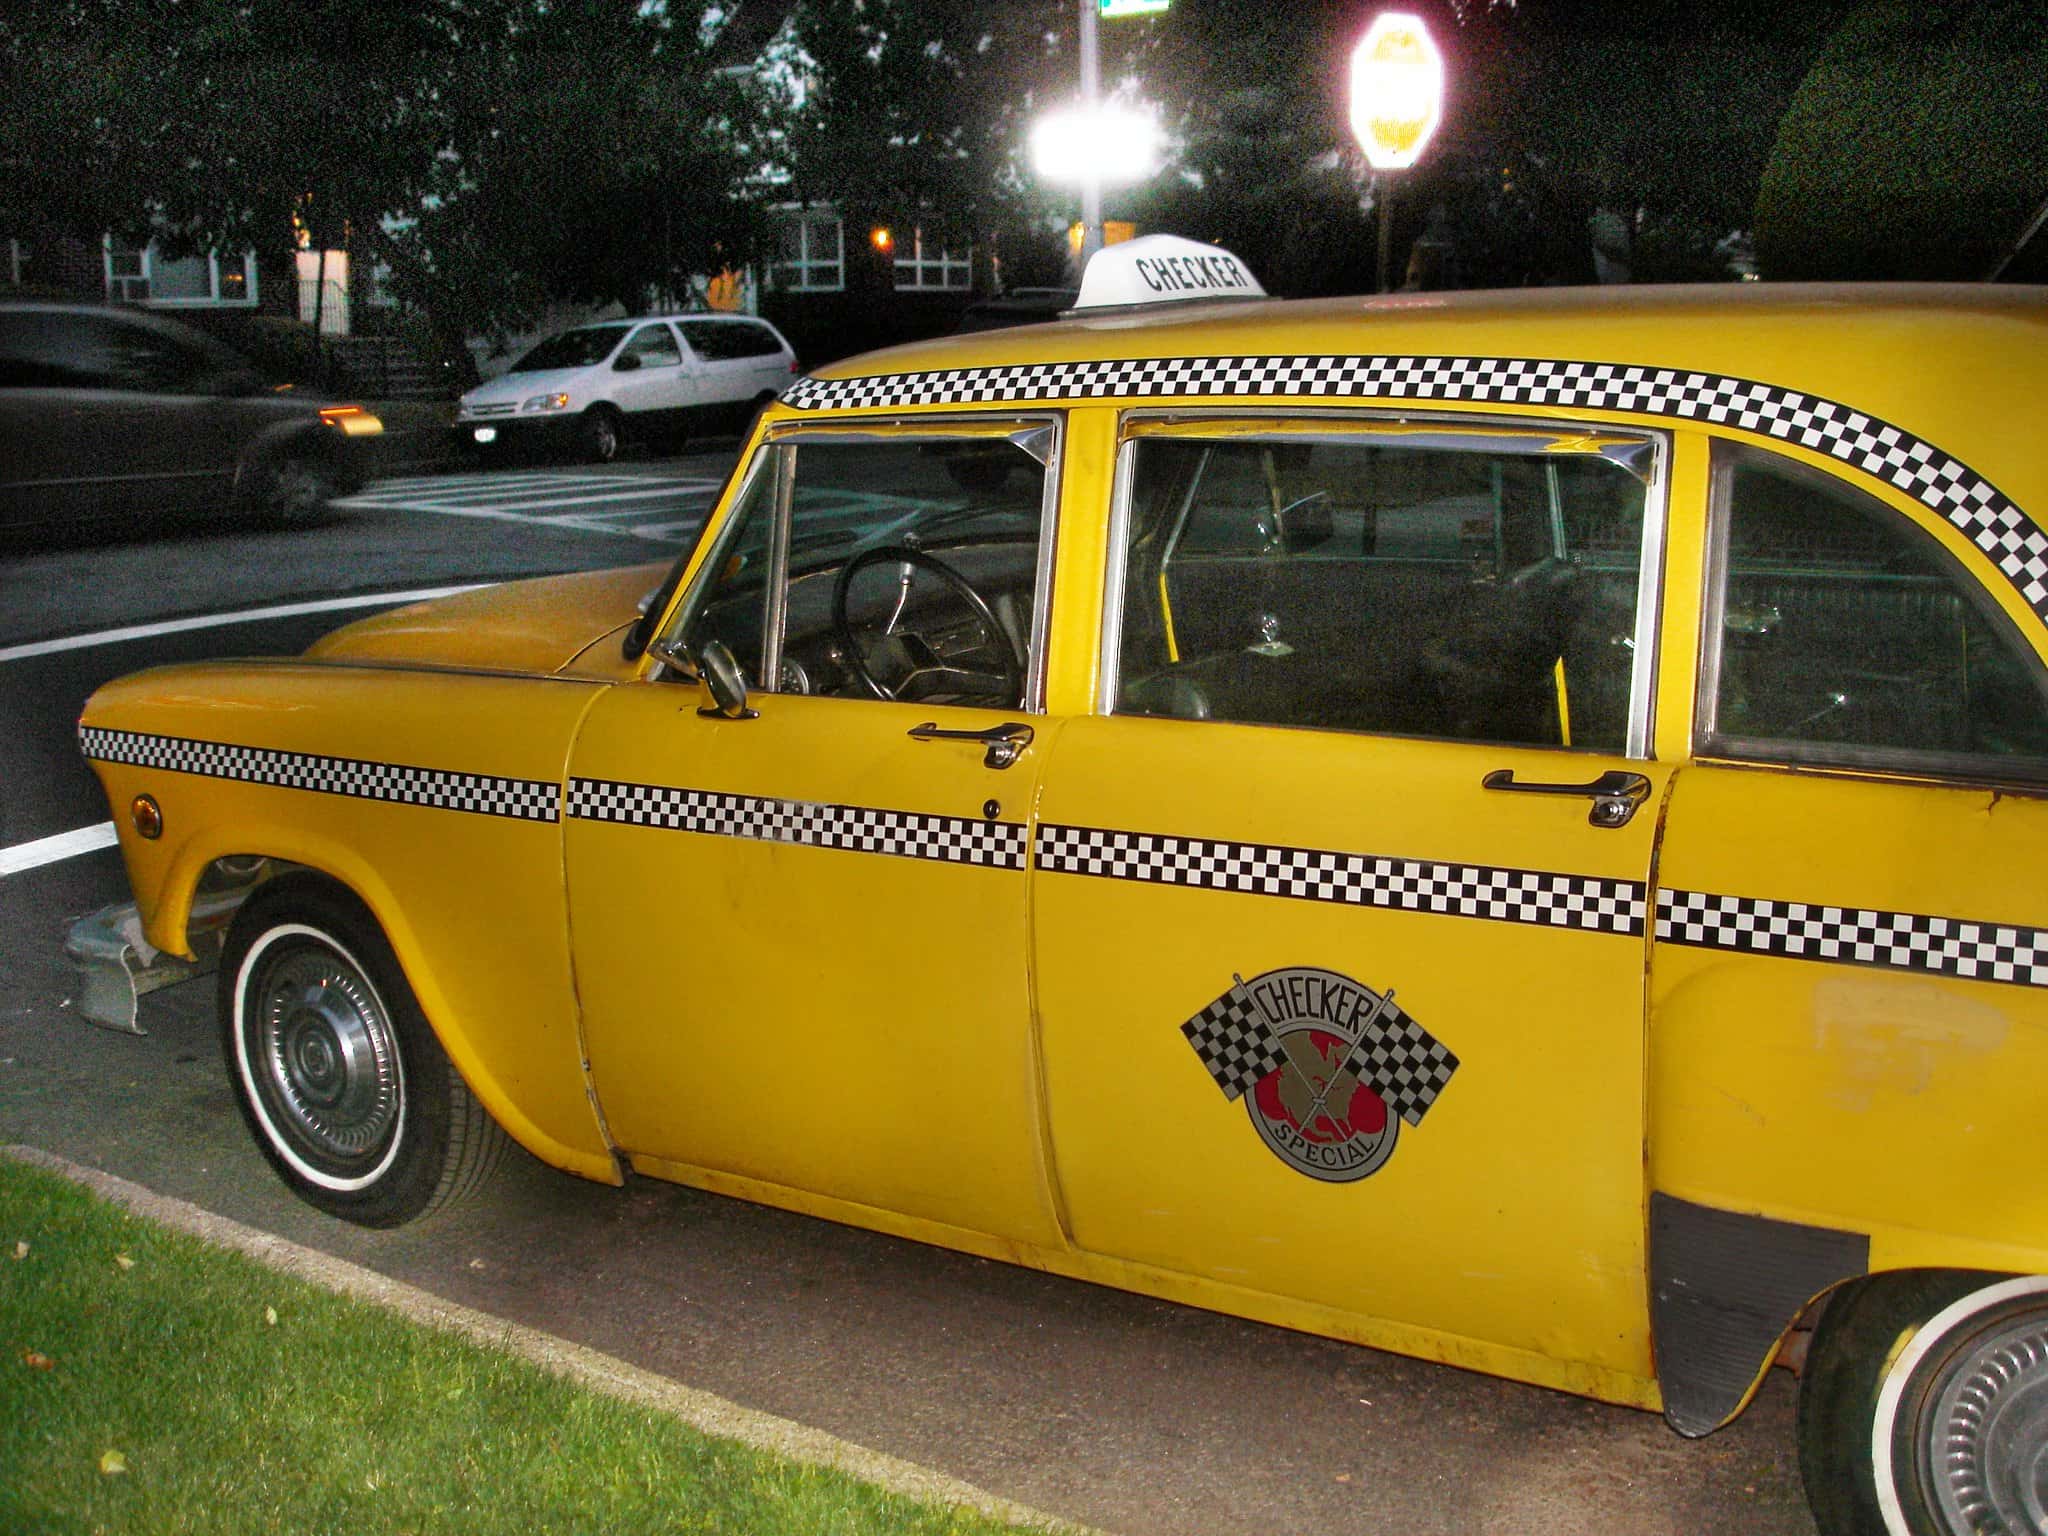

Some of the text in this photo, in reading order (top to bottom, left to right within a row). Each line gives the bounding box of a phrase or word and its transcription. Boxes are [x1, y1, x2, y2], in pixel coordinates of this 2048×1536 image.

[1136, 256, 1248, 291] CHECKER
[1254, 977, 1374, 1034] CHECKER
[1275, 1124, 1374, 1166] SPECIAL
